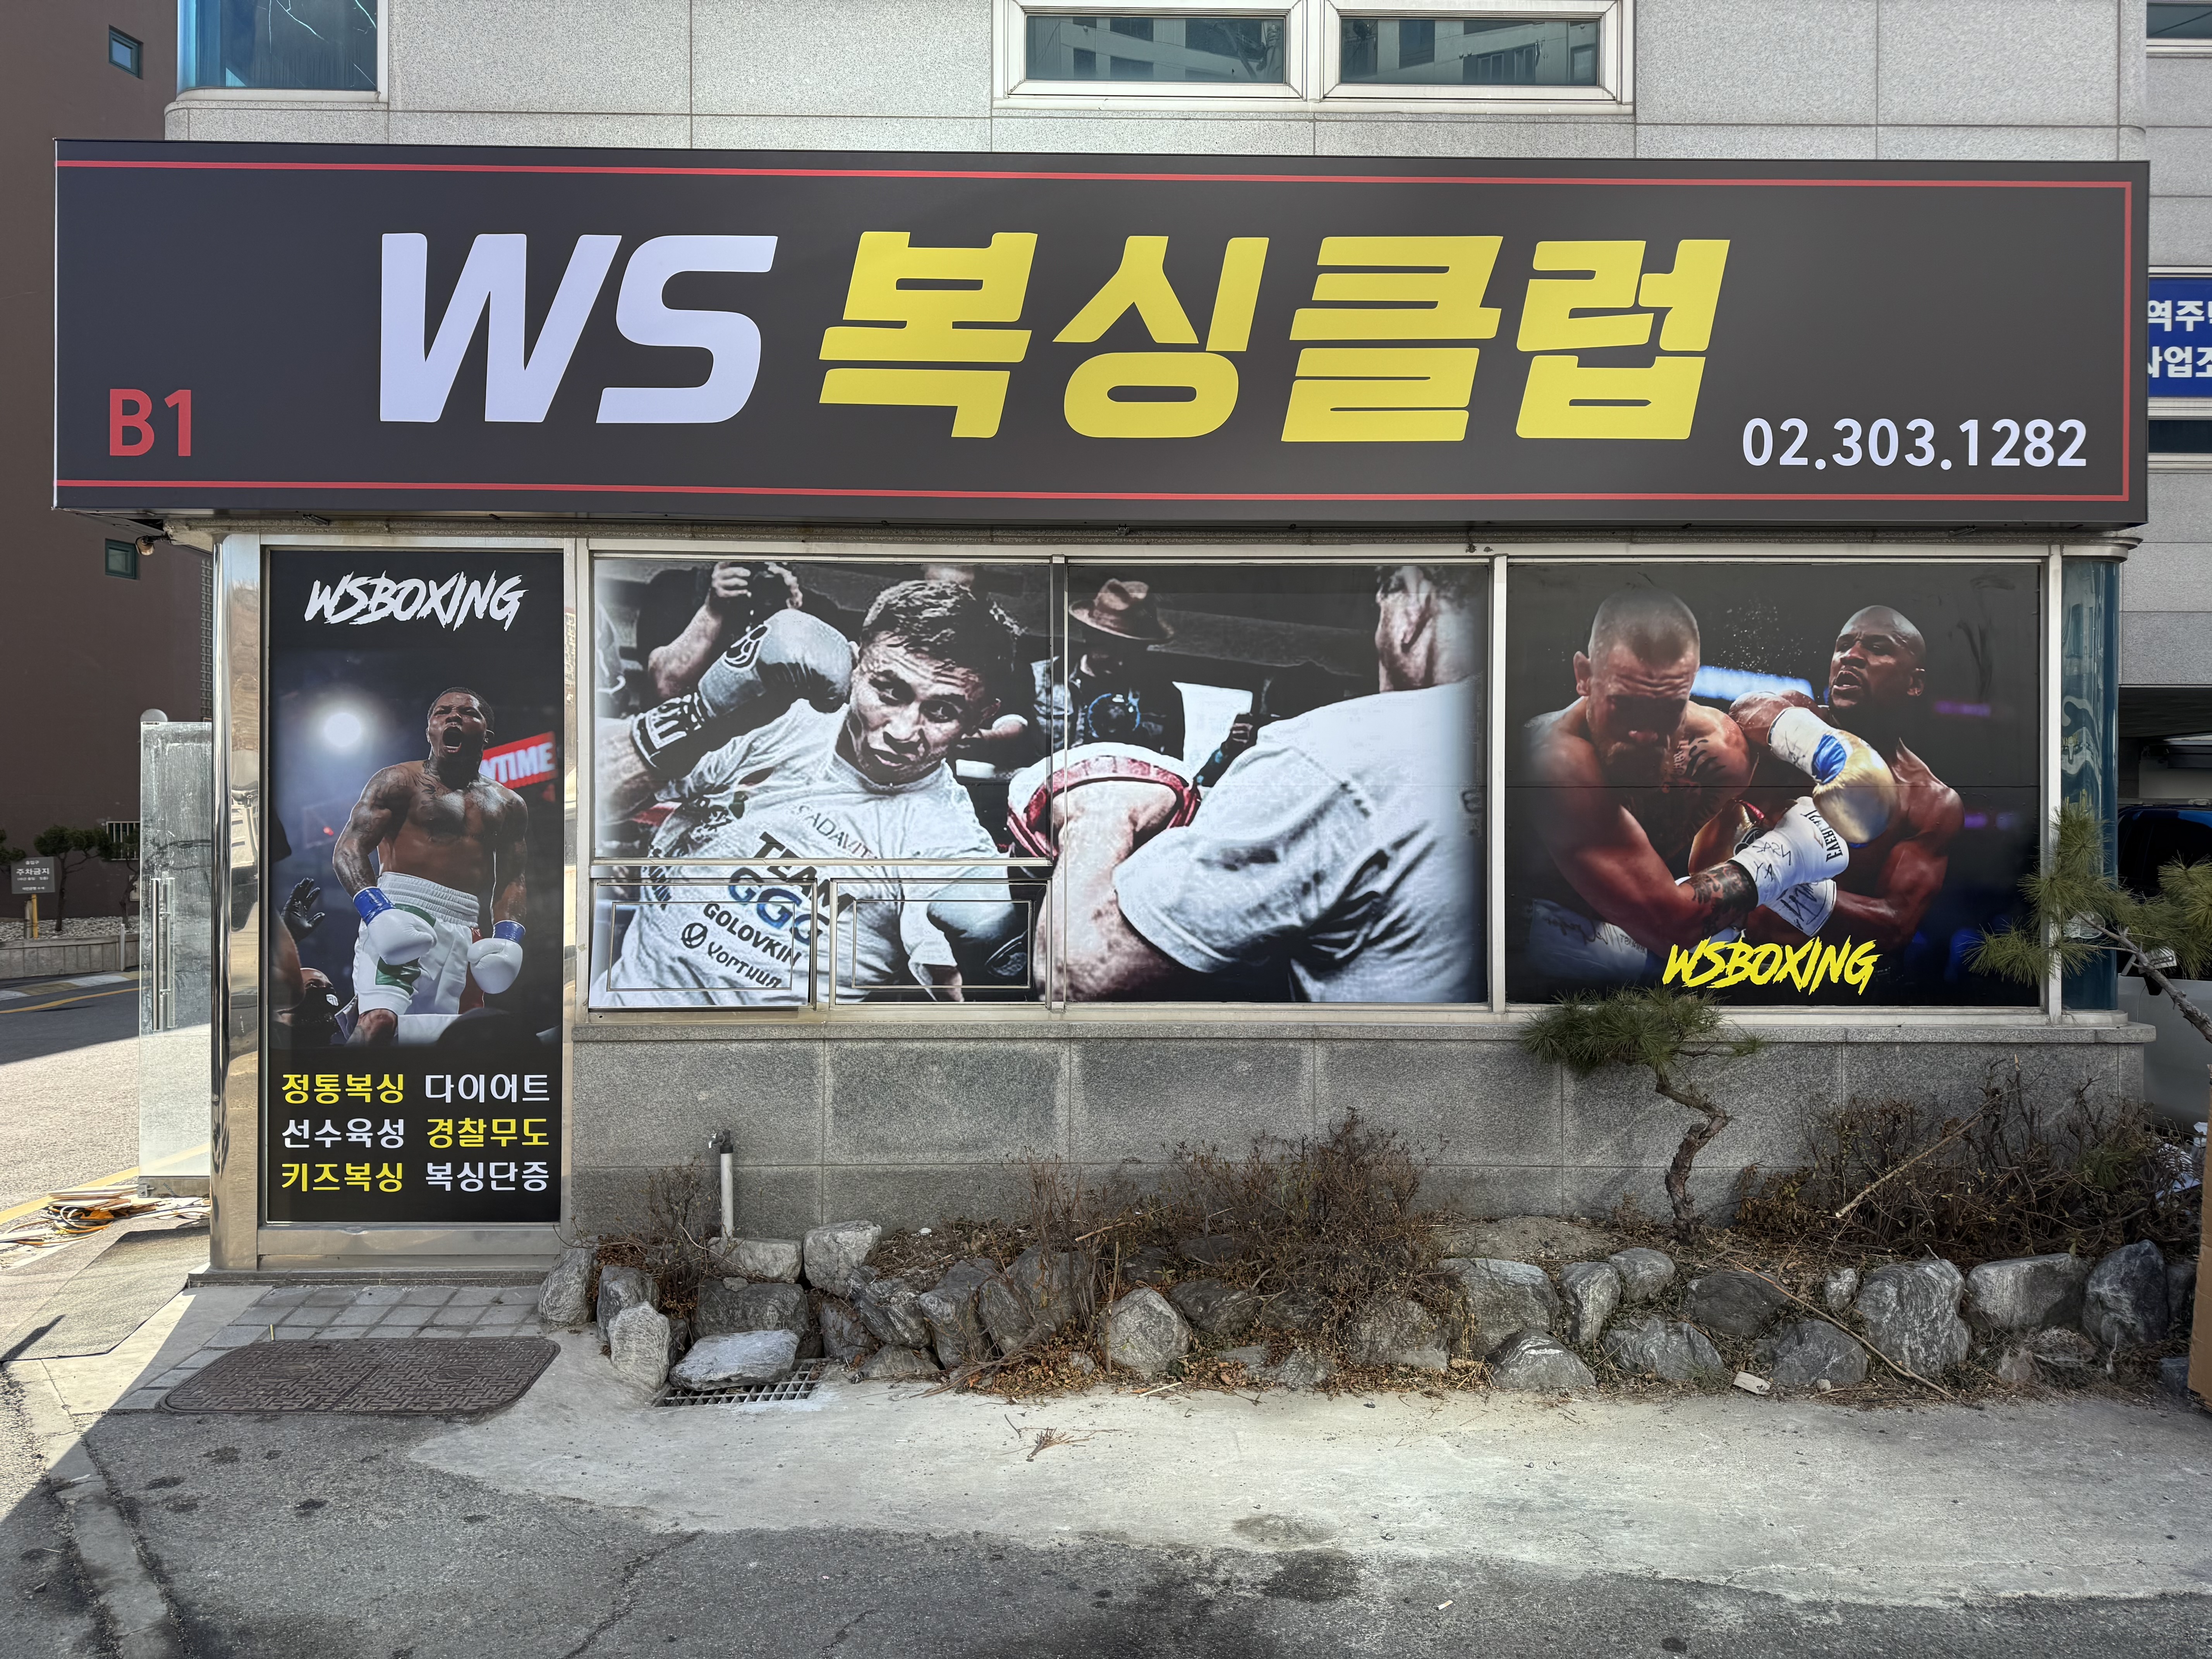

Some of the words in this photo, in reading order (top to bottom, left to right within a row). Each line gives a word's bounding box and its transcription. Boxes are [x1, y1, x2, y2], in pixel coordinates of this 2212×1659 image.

[380, 233, 778, 423] WS
[819, 231, 1730, 441] 복싱클럽
[2148, 300, 2212, 332] 역주
[110, 388, 191, 456] B1
[1743, 417, 2087, 470] 02.303.1282
[304, 570, 529, 631] WSBOXING
[753, 831, 856, 919] TEAM
[703, 903, 802, 967] GOLOVKIN
[728, 867, 830, 946] GGG
[1662, 935, 1883, 996] WSBOXING
[282, 1074, 404, 1104] 정통복싱
[426, 1074, 550, 1103] 다이어트
[282, 1118, 404, 1148] 선수육성
[427, 1118, 549, 1148] 경찰무도
[282, 1163, 402, 1192] 키즈복싱
[426, 1162, 549, 1192] 복싱단증
